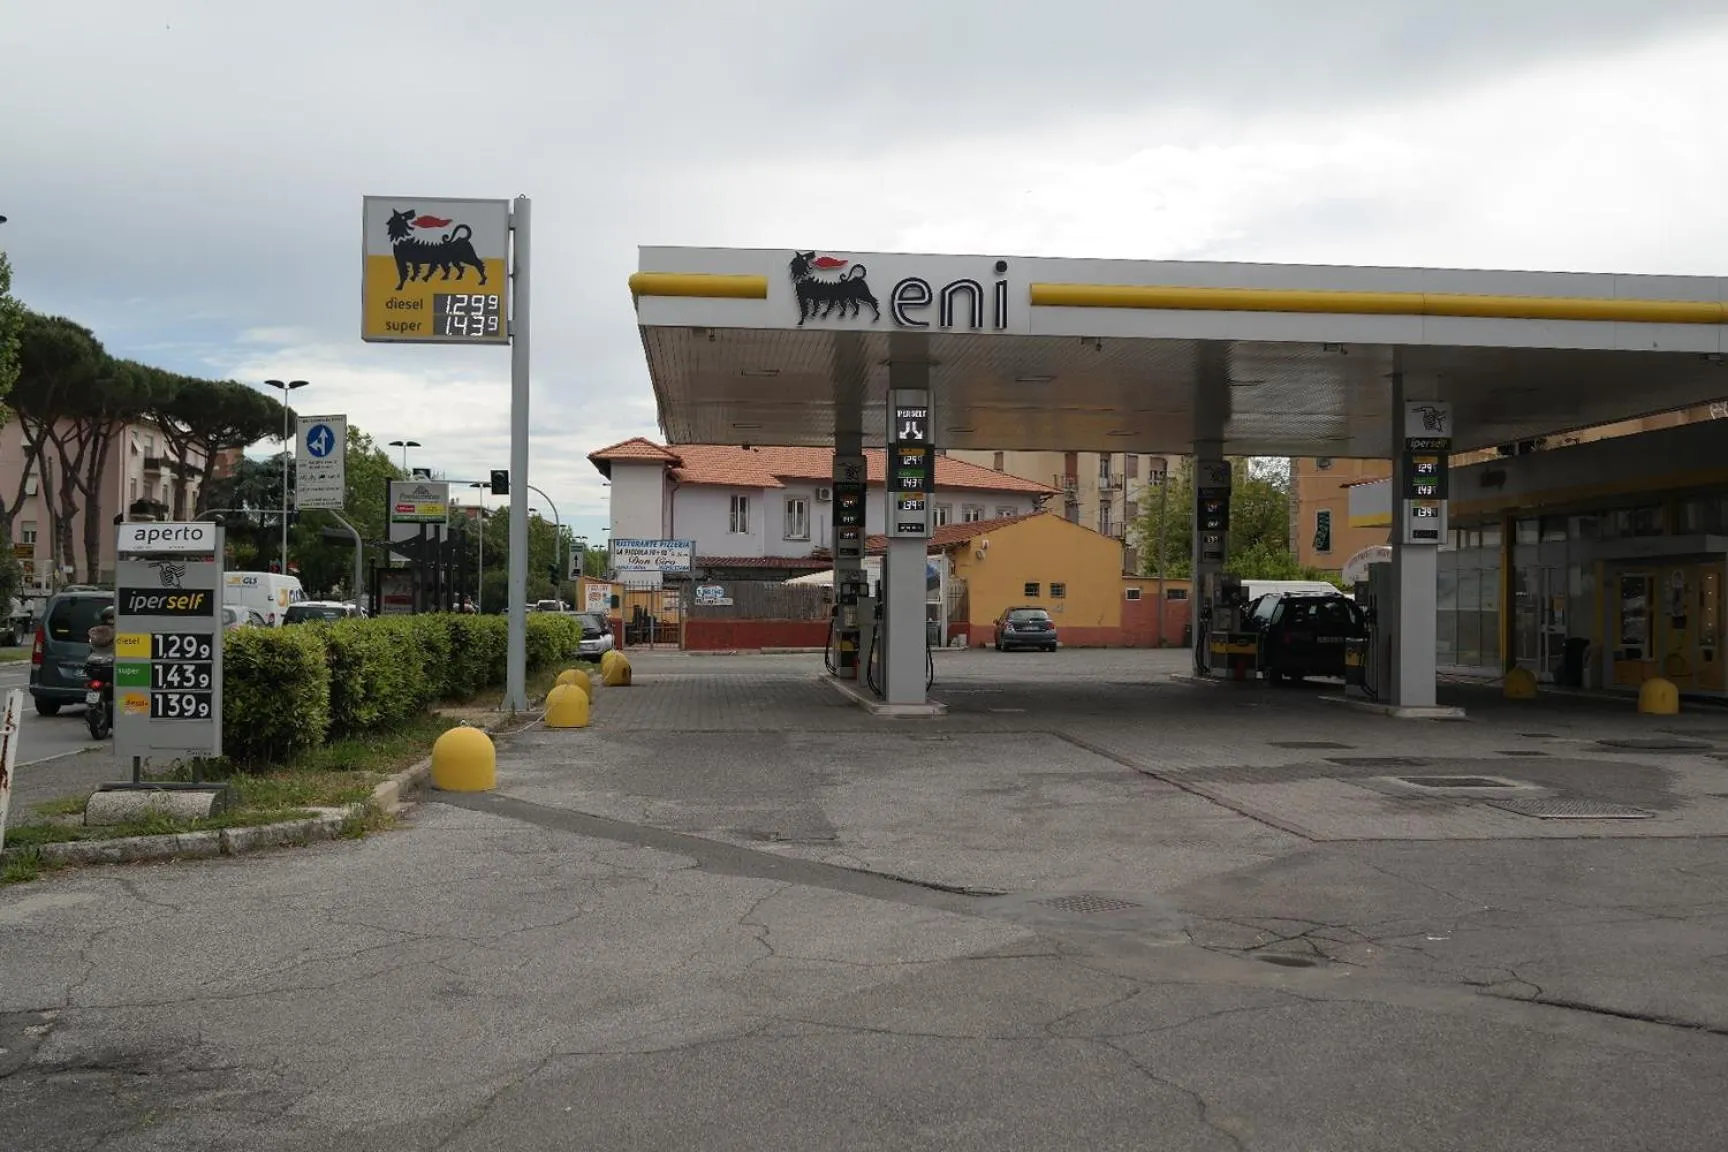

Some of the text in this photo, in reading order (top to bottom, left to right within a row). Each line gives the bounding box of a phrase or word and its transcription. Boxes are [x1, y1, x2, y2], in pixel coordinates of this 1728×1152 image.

[891, 260, 1008, 329] eni
[385, 297, 424, 311] diesel
[385, 320, 422, 333] super
[134, 526, 204, 544] aperto
[243, 576, 258, 585] GLS
[128, 590, 205, 613] iperself
[116, 636, 141, 645] diesel
[117, 667, 141, 676] super
